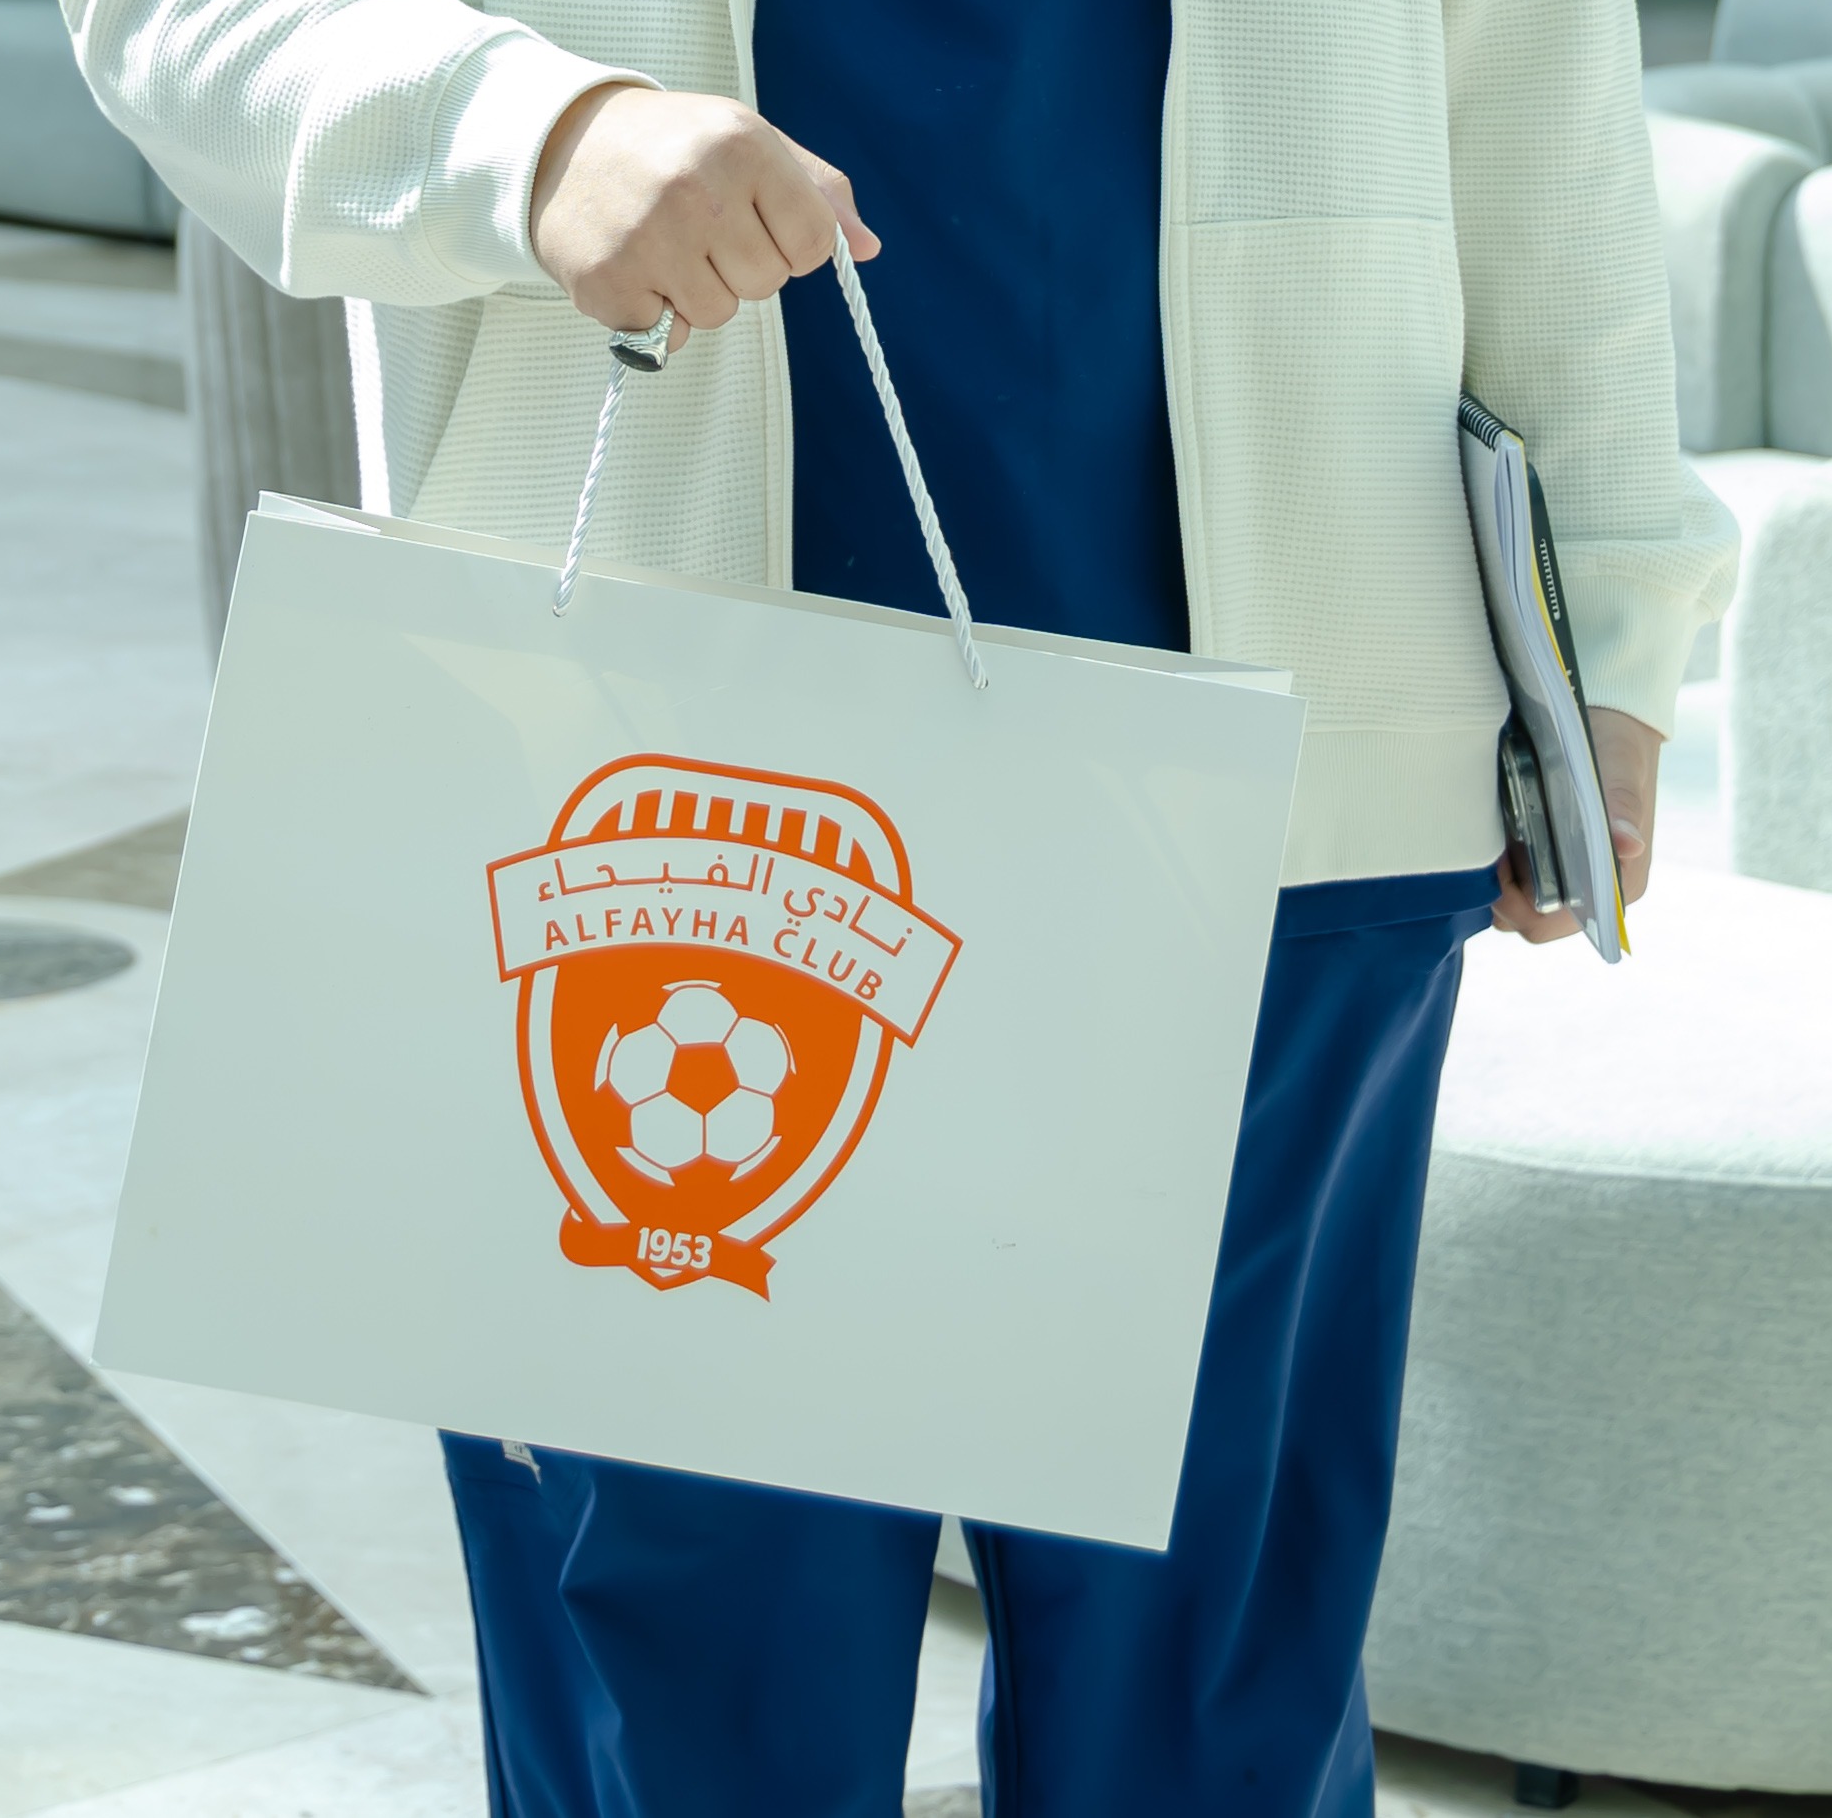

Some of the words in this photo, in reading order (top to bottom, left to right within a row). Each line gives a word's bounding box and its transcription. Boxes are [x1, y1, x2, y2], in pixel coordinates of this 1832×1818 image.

[537, 853, 775, 903] الفيحاء
[783, 887, 913, 958] نادي
[544, 907, 750, 951] ALFAYHA
[773, 927, 884, 1001] CLUB
[636, 1226, 714, 1271] 1953
